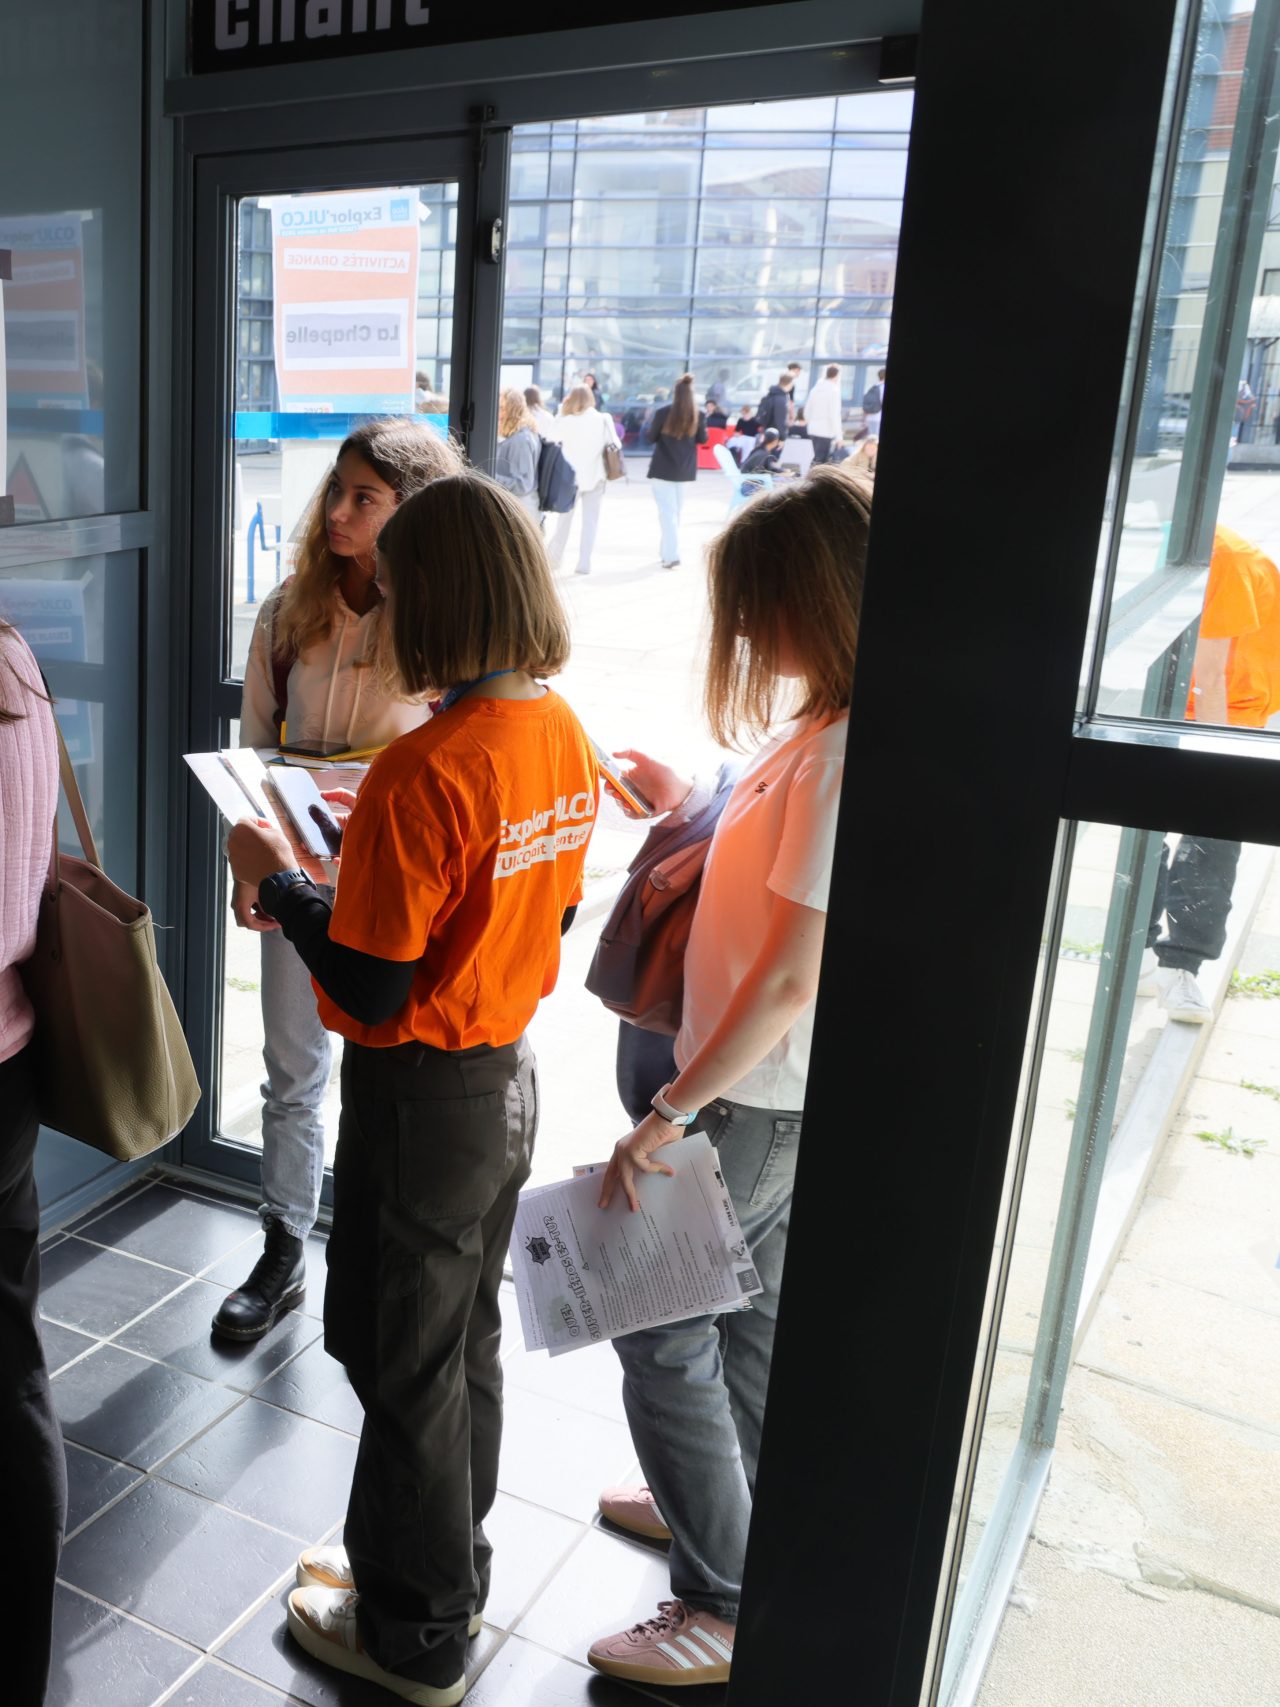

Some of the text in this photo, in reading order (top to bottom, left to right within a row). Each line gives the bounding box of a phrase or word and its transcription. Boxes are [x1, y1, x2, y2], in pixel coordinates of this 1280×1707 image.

[501, 792, 594, 845] ExplorLC
[560, 1303, 581, 1337] QUEL
[561, 1257, 602, 1341] SUPER-HÉROS
